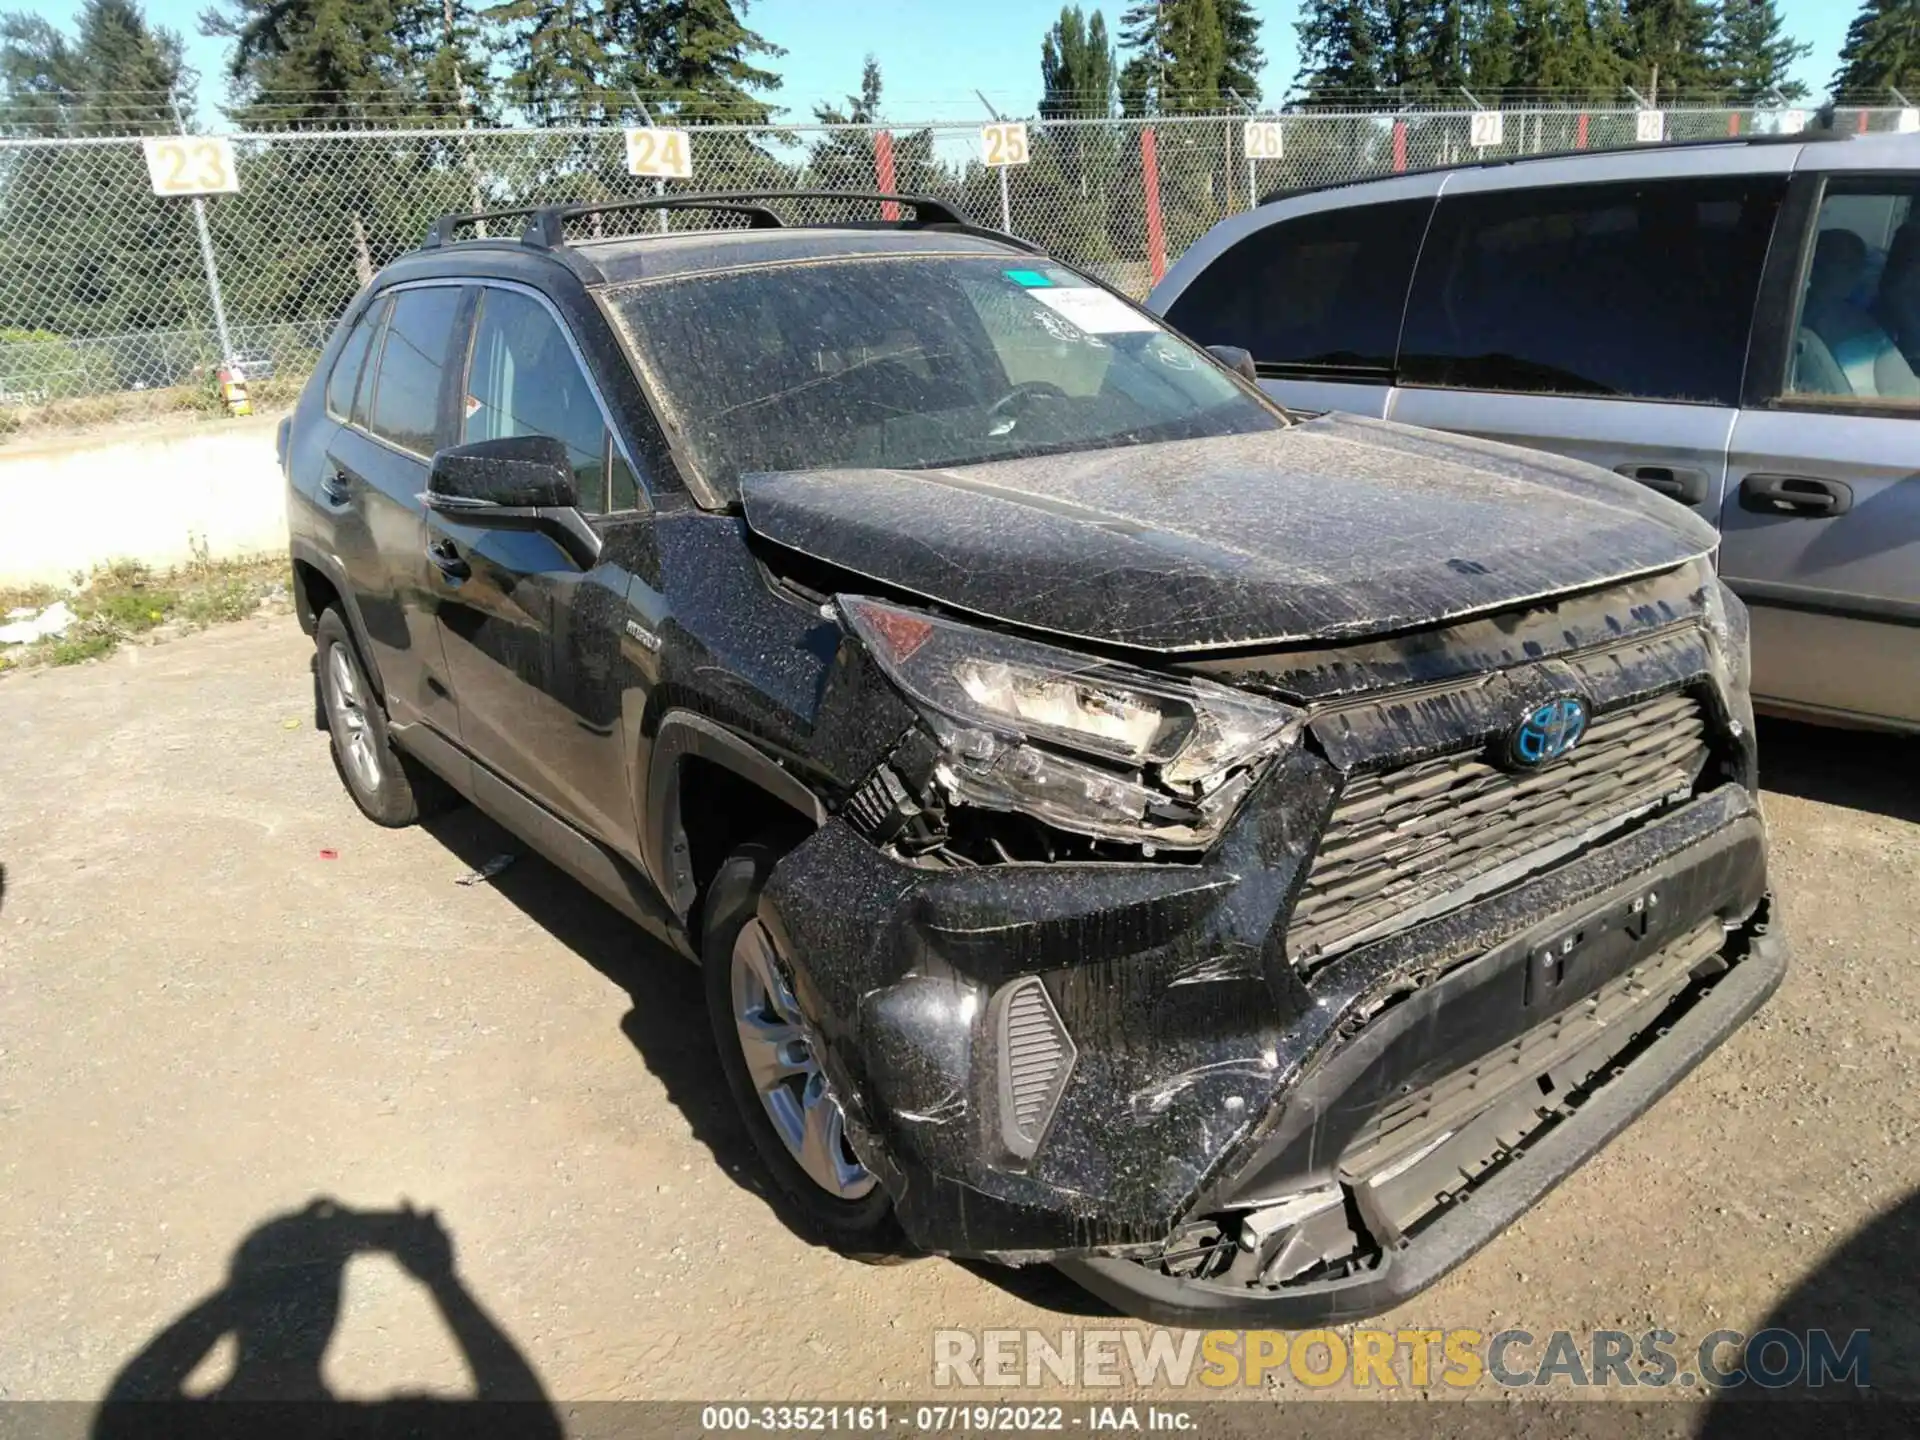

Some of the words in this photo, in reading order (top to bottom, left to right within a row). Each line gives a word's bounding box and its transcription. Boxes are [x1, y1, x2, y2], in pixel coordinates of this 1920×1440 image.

[1249, 125, 1278, 155] 26
[1476, 115, 1497, 142] 27
[1641, 113, 1660, 138] 28
[633, 131, 684, 174] 24
[985, 126, 1023, 163] 25
[158, 143, 226, 190] 23
